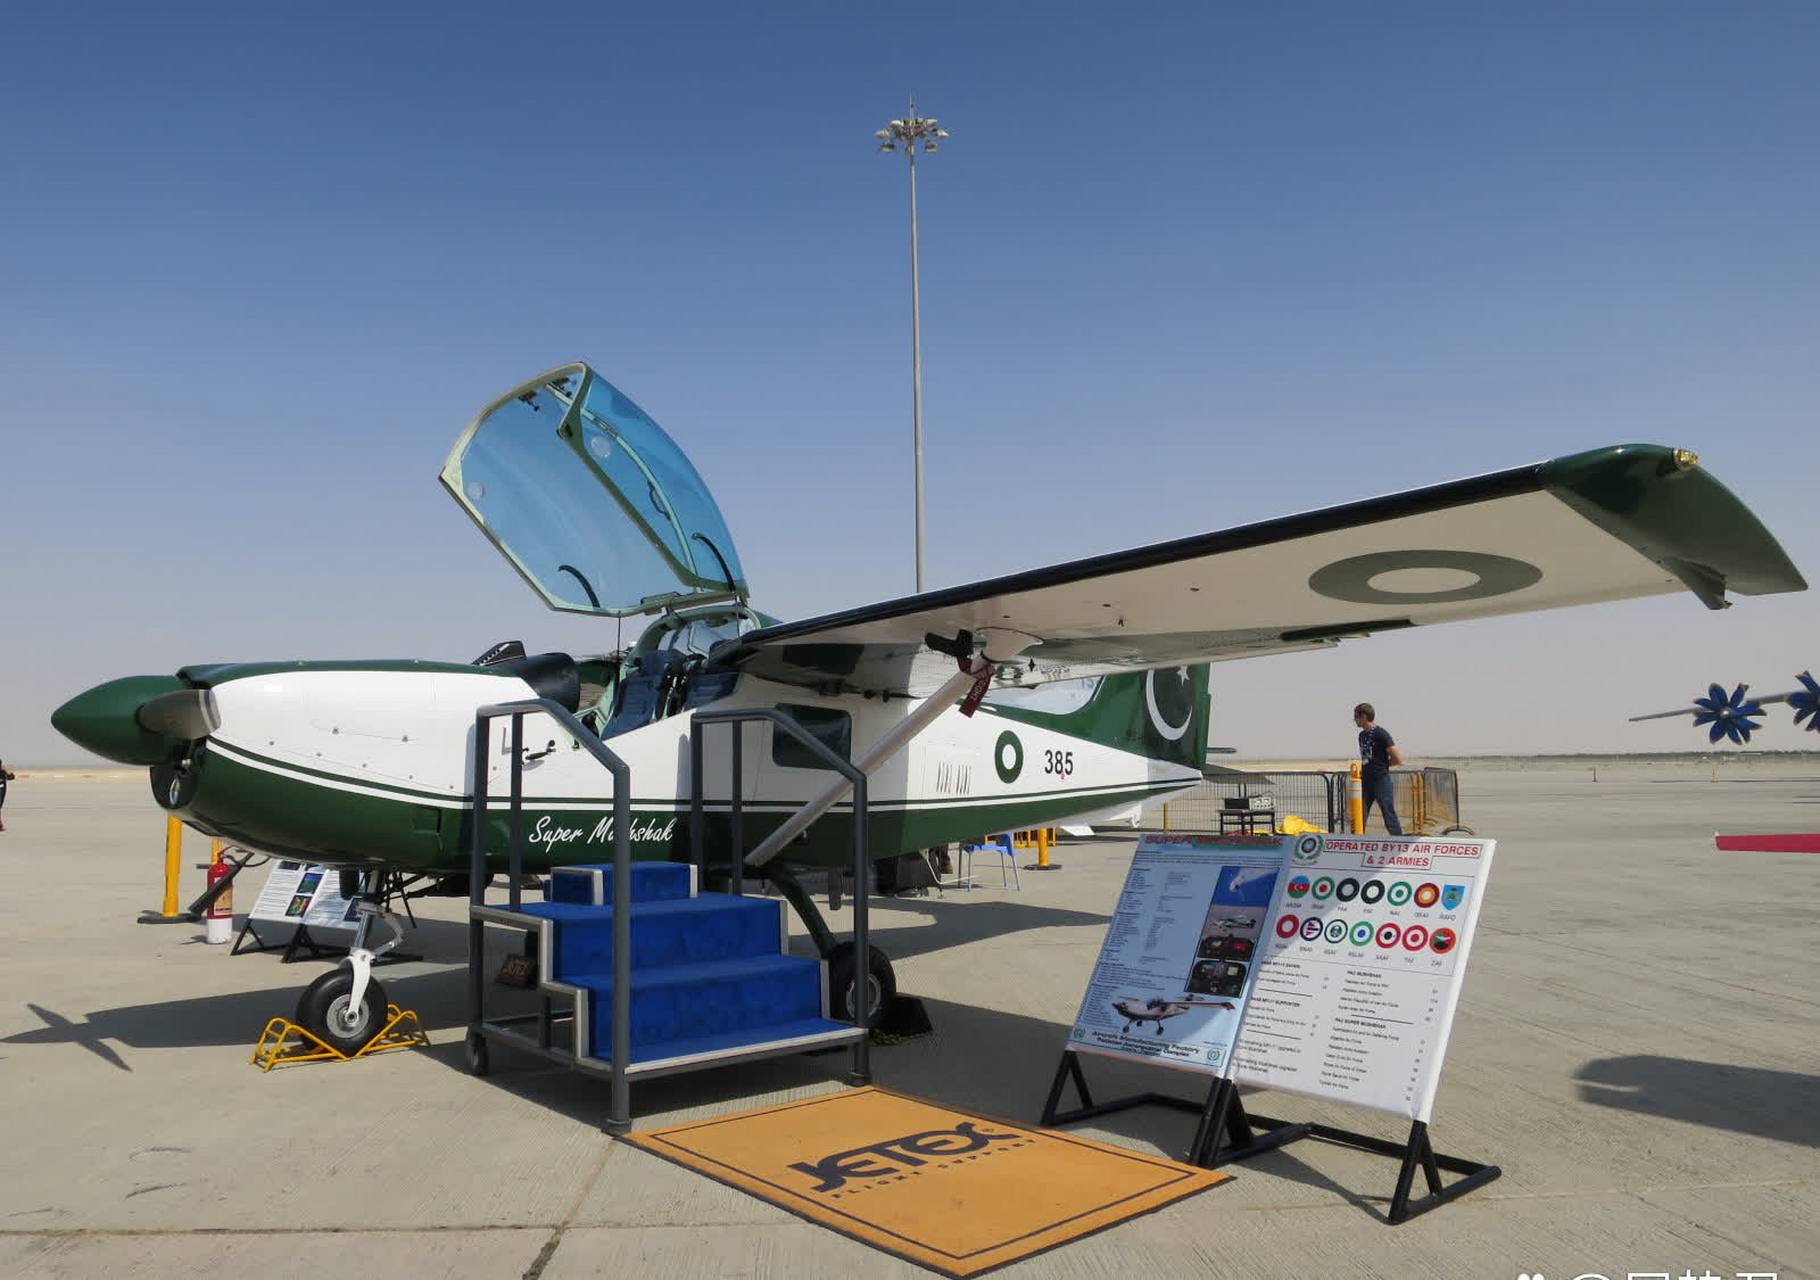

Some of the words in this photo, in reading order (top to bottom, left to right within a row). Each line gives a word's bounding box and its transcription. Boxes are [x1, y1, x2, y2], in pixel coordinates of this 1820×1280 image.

[1044, 749, 1074, 776] 385
[529, 815, 583, 853] Super
[587, 816, 677, 844] Muhshak
[1326, 841, 1379, 852] OPERATED
[1412, 844, 1431, 853] AIR
[1434, 845, 1479, 856] FORCES
[1366, 855, 1374, 865] &
[1377, 856, 1385, 865] 2
[1388, 857, 1430, 867] ARMIES
[786, 1121, 1022, 1193] JETEX
